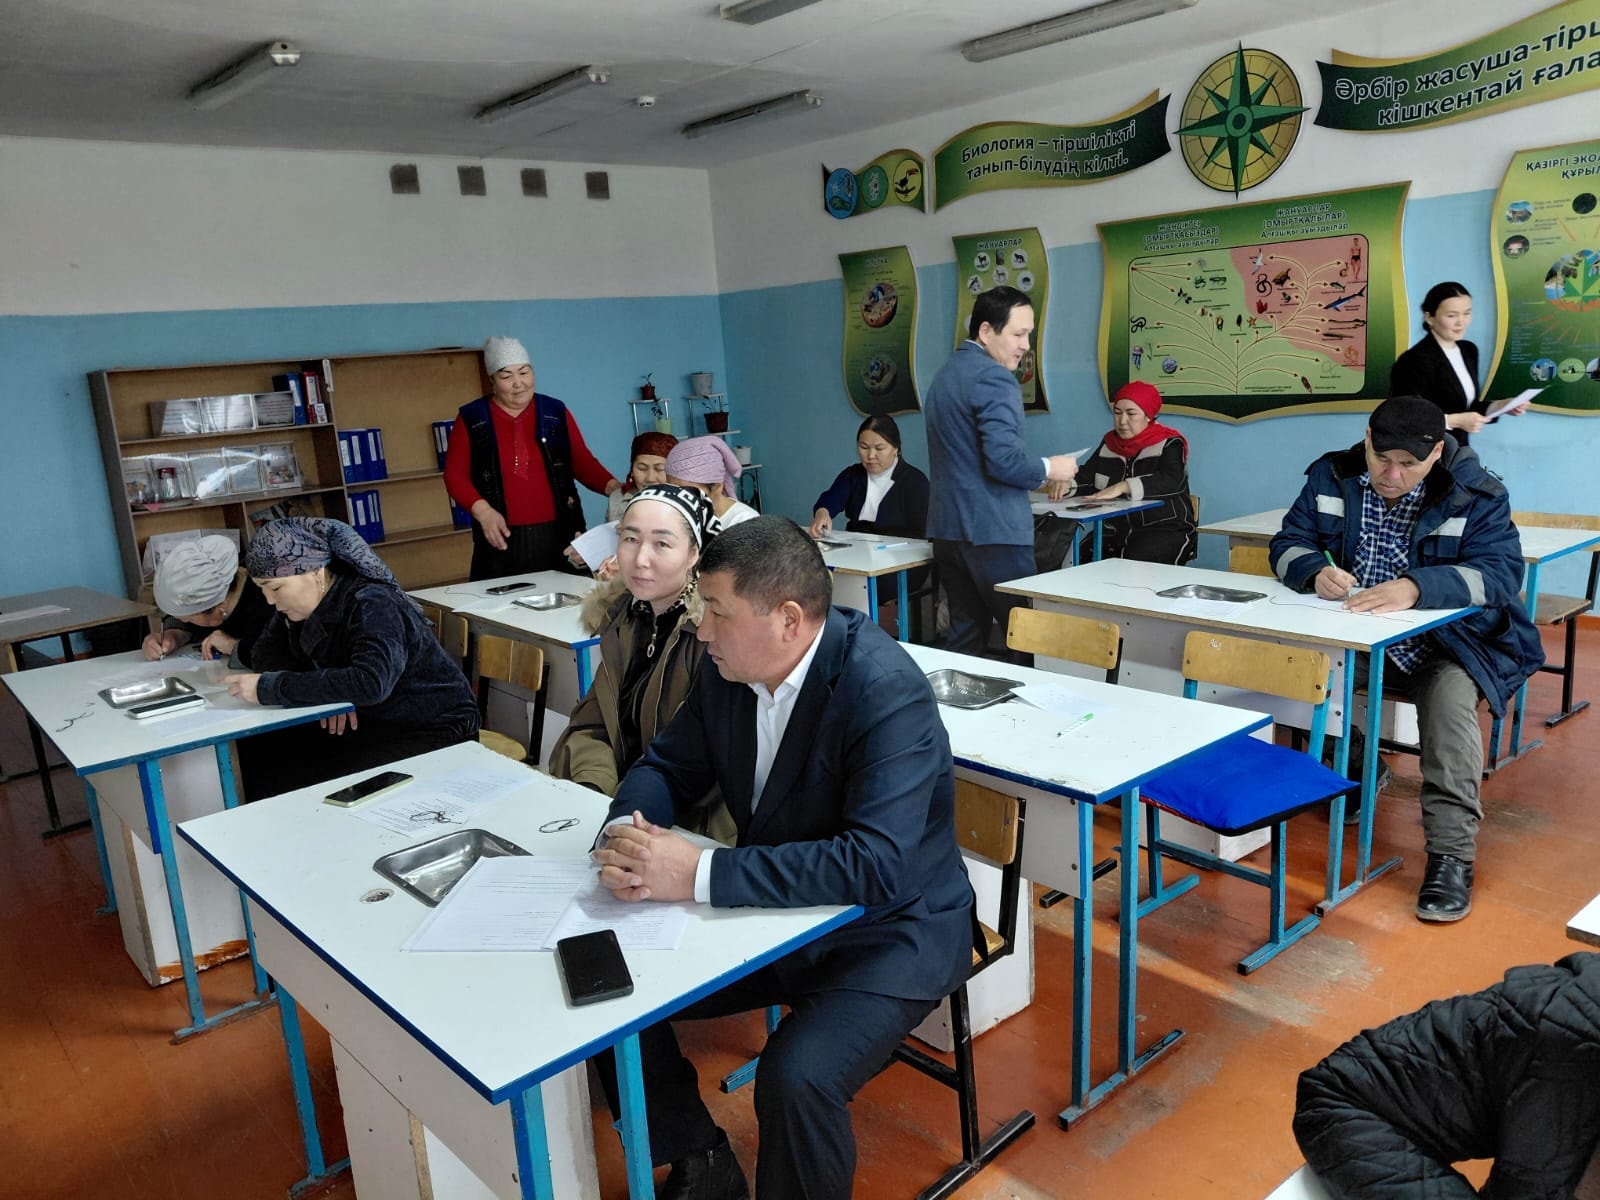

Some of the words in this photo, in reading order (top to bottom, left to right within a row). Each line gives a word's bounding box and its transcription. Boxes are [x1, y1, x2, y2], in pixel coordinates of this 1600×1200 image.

[1335, 76, 1409, 105] Әрбір
[1377, 71, 1523, 126] кішкентай
[962, 136, 1034, 164] Биология
[1052, 119, 1137, 154] тіршілікті
[966, 155, 1080, 182] танып-білудің
[1084, 148, 1129, 174] кілті.
[1526, 157, 1569, 172] ҚАЗІРГІ
